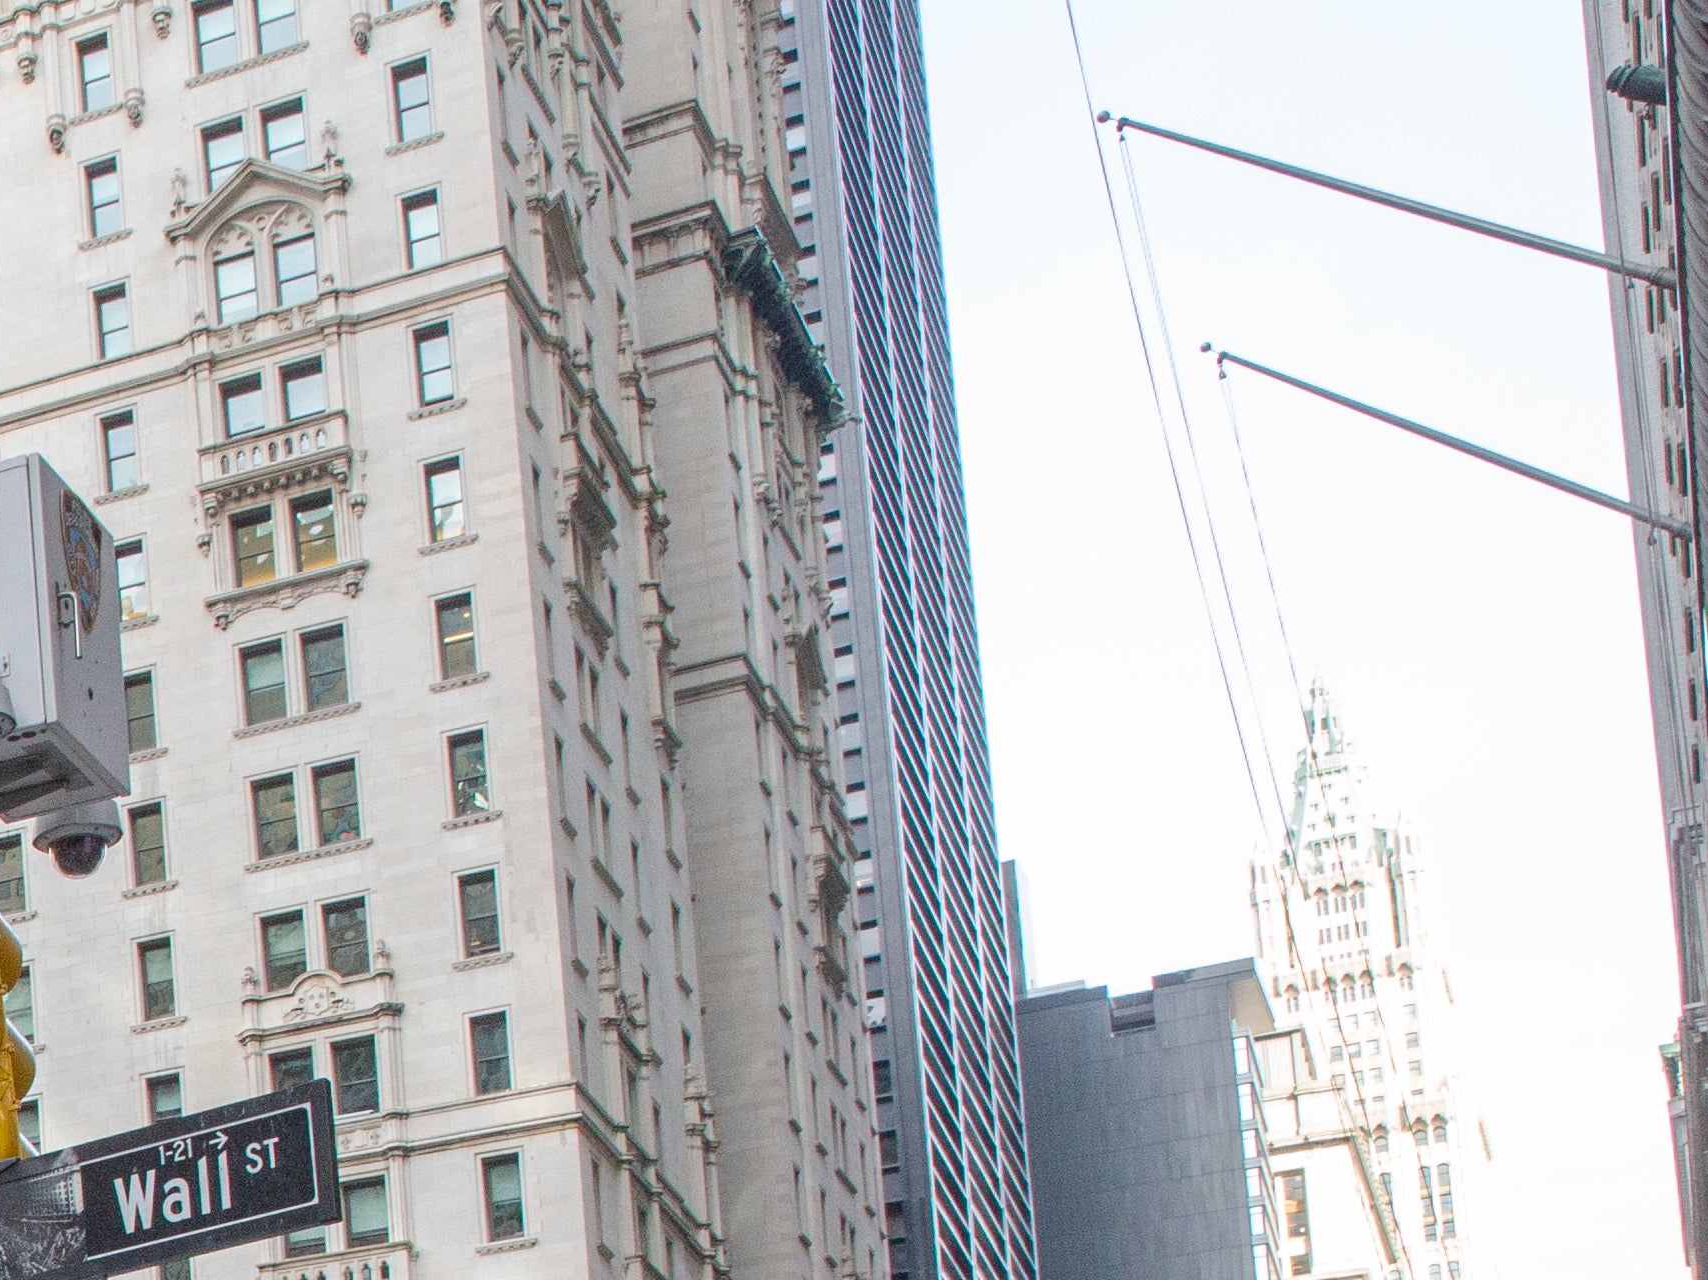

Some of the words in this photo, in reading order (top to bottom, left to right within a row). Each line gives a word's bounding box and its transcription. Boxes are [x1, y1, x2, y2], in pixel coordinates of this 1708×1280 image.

[159, 1138, 193, 1166] 1-21
[113, 1150, 232, 1235] Wall
[245, 1137, 280, 1175] ST
